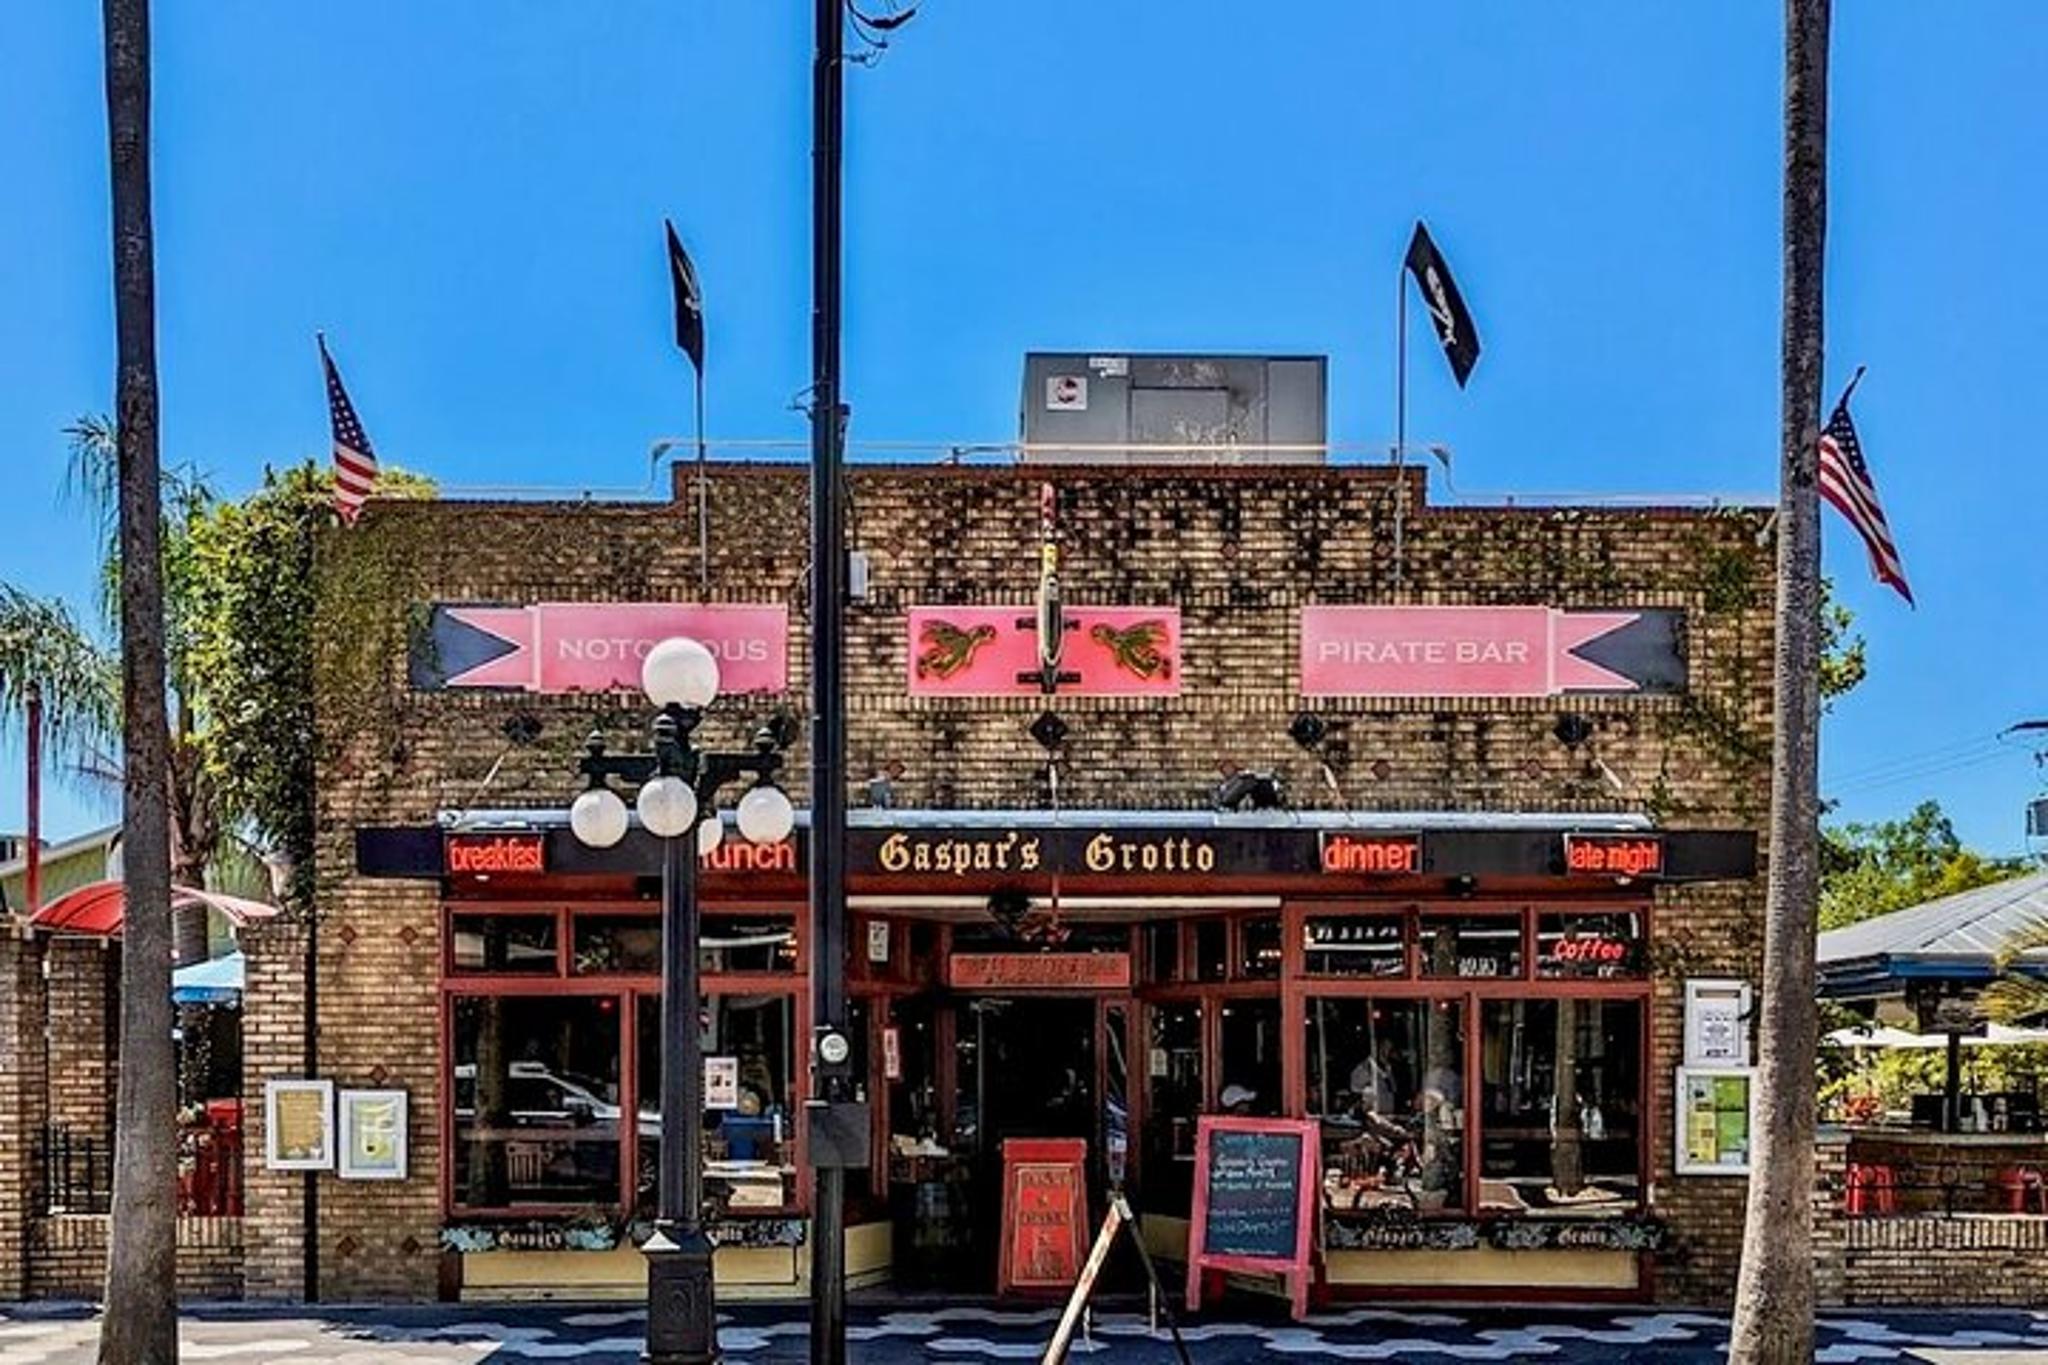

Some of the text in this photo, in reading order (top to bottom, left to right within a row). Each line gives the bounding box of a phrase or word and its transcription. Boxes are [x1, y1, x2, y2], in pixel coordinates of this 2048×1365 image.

[1319, 641, 1529, 664] PIRATE BAR
[449, 838, 544, 873] breakfast
[879, 831, 1215, 876] Gaspar's Grotto
[1325, 837, 1419, 872] dinner
[1568, 842, 1660, 876] late night
[1553, 938, 1625, 962] Coffee
